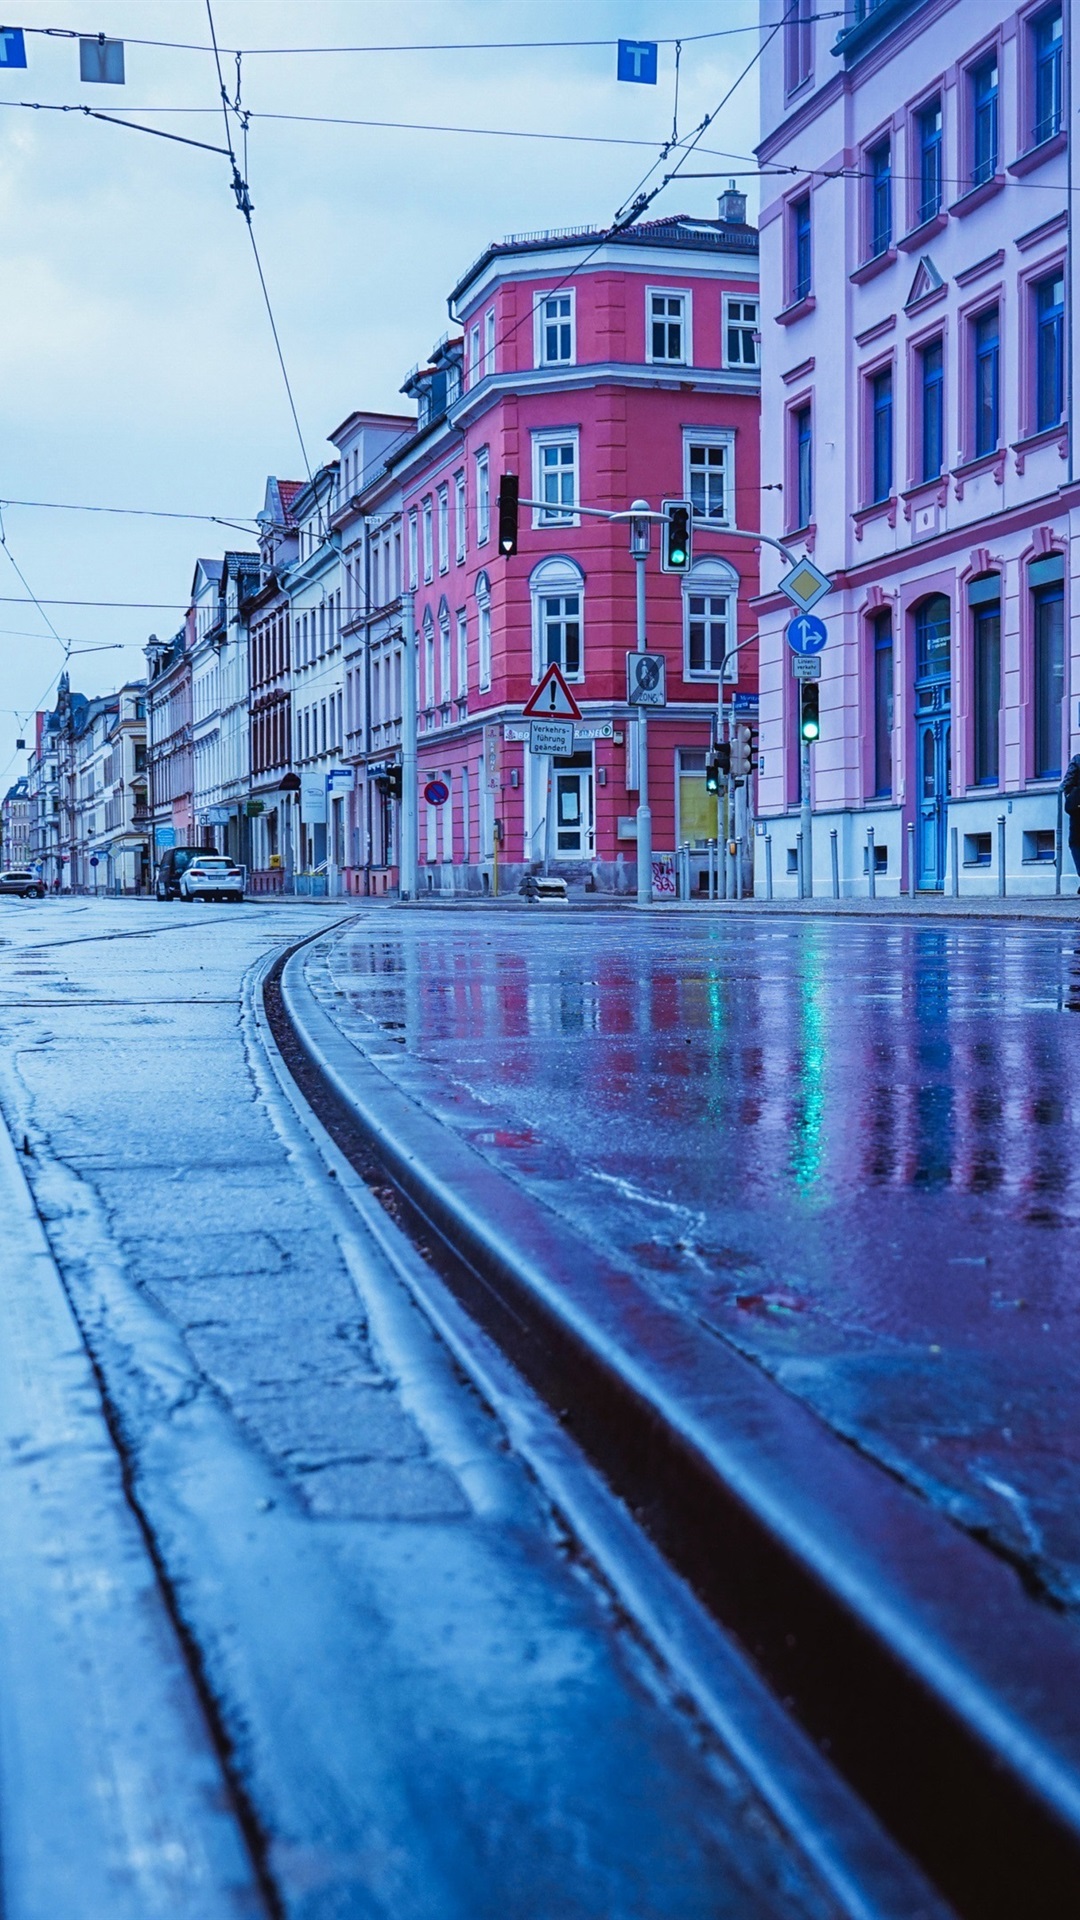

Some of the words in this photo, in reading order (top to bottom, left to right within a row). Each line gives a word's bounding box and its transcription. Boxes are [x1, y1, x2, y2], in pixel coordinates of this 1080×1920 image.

[626, 46, 649, 77] T
[533, 724, 570, 734] Verkehrs-
[536, 734, 566, 745] führung
[534, 743, 567, 752] geändert
